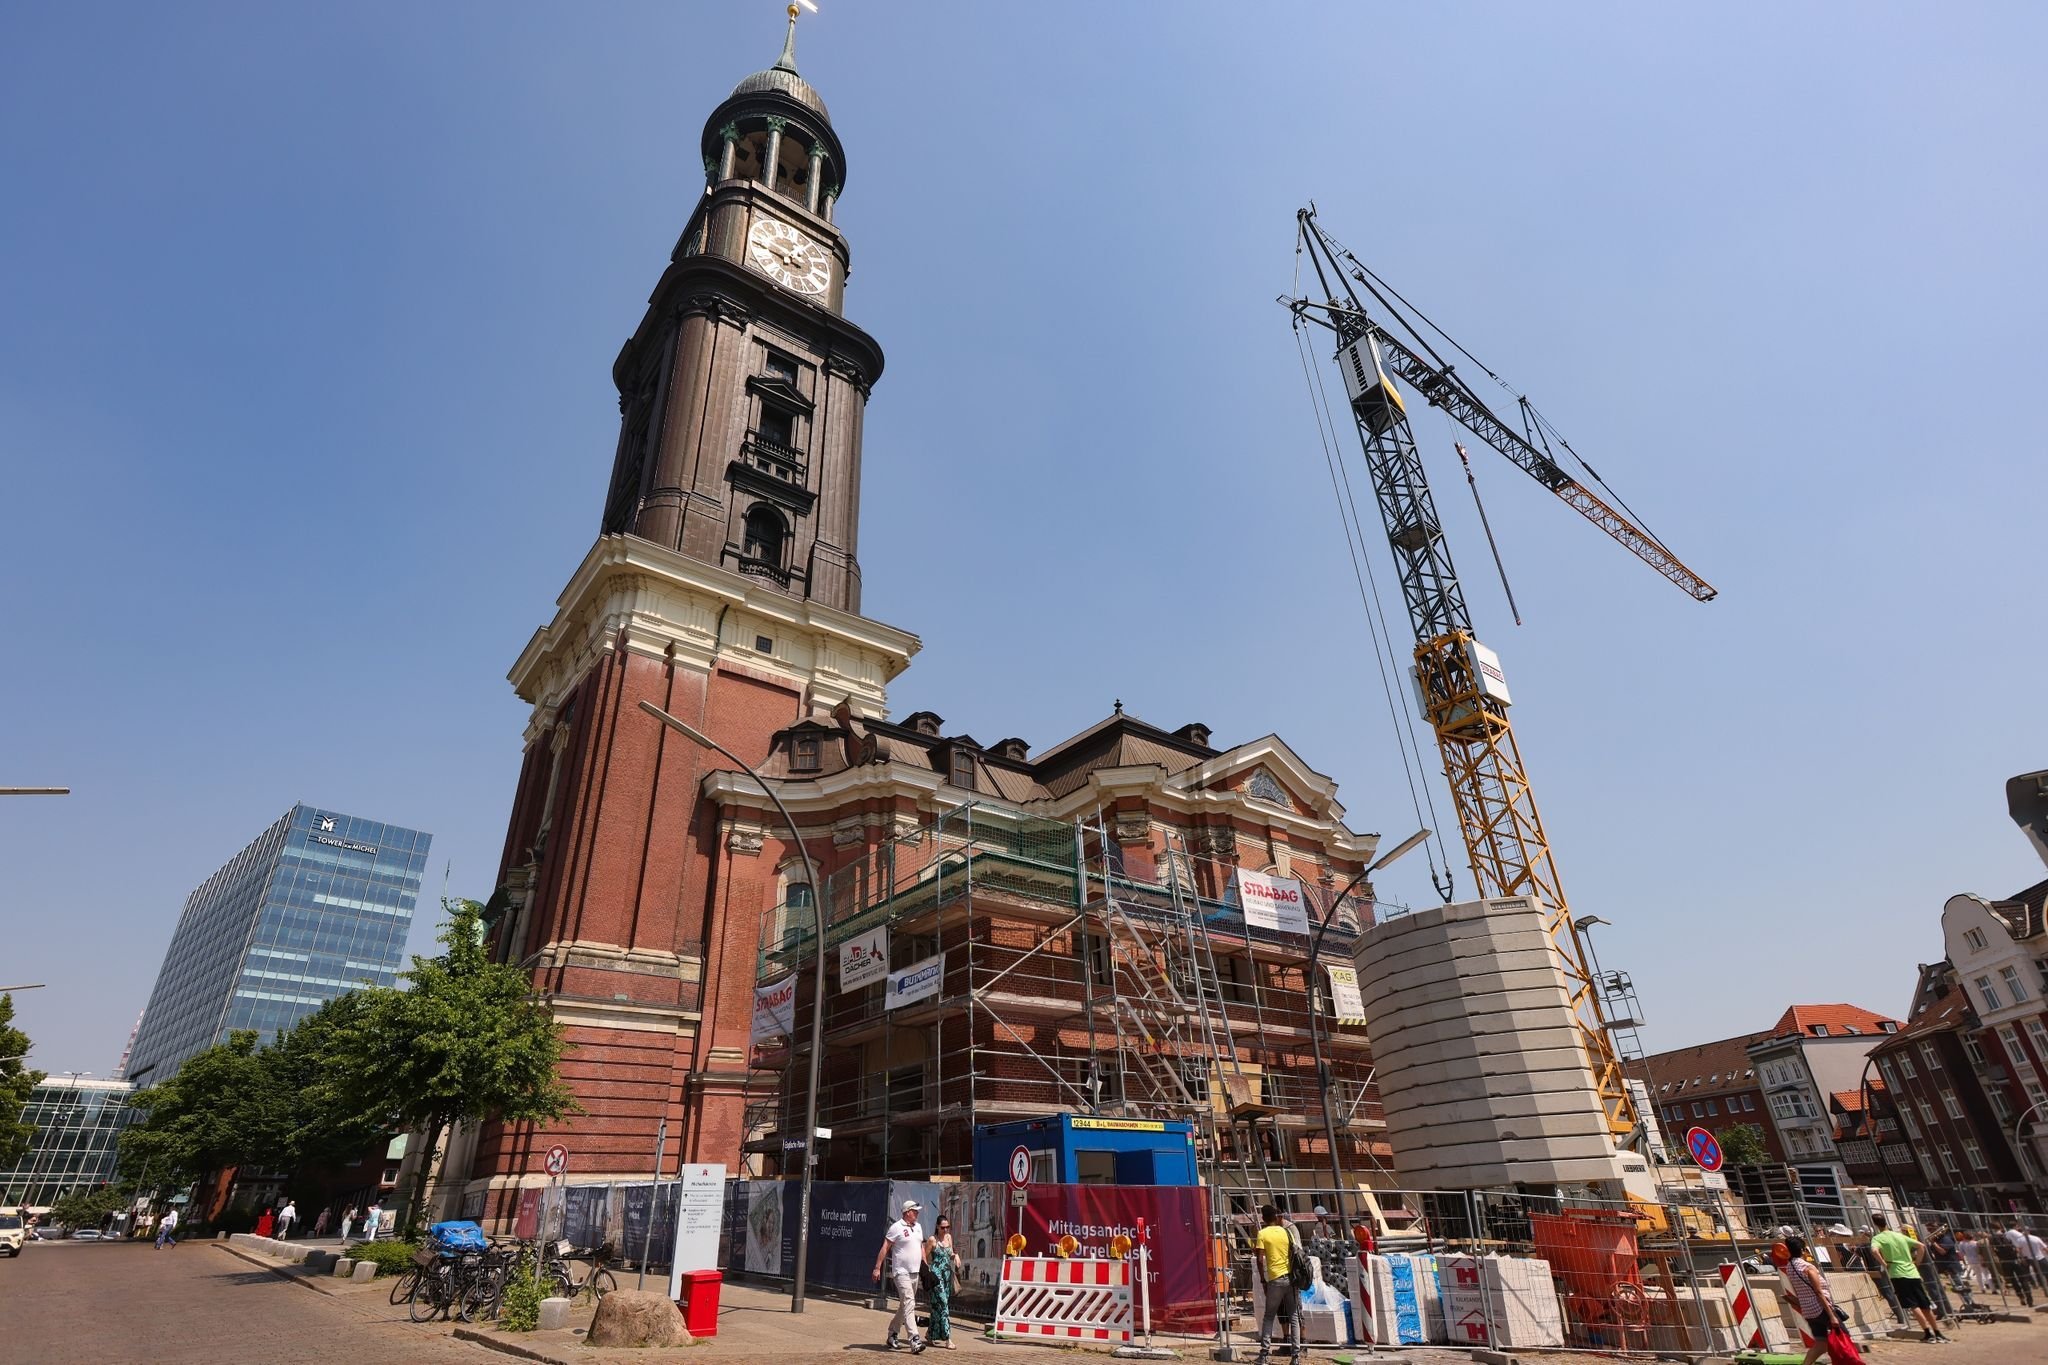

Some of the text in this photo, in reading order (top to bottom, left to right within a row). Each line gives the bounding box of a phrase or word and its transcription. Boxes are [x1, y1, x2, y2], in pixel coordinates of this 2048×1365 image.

[1349, 345, 1369, 392] LIEBHERR
[317, 836, 342, 847] TOWER
[351, 844, 377, 854] MICHEL
[1243, 881, 1299, 903] STRABAG
[844, 958, 871, 974] DÄCHER
[756, 986, 793, 1012] STRABAG
[821, 1208, 839, 1221] Kirche
[839, 1211, 852, 1222] und
[1048, 1219, 1152, 1240] Mittagsandact
[1074, 1241, 1153, 1261] Orgelusk
